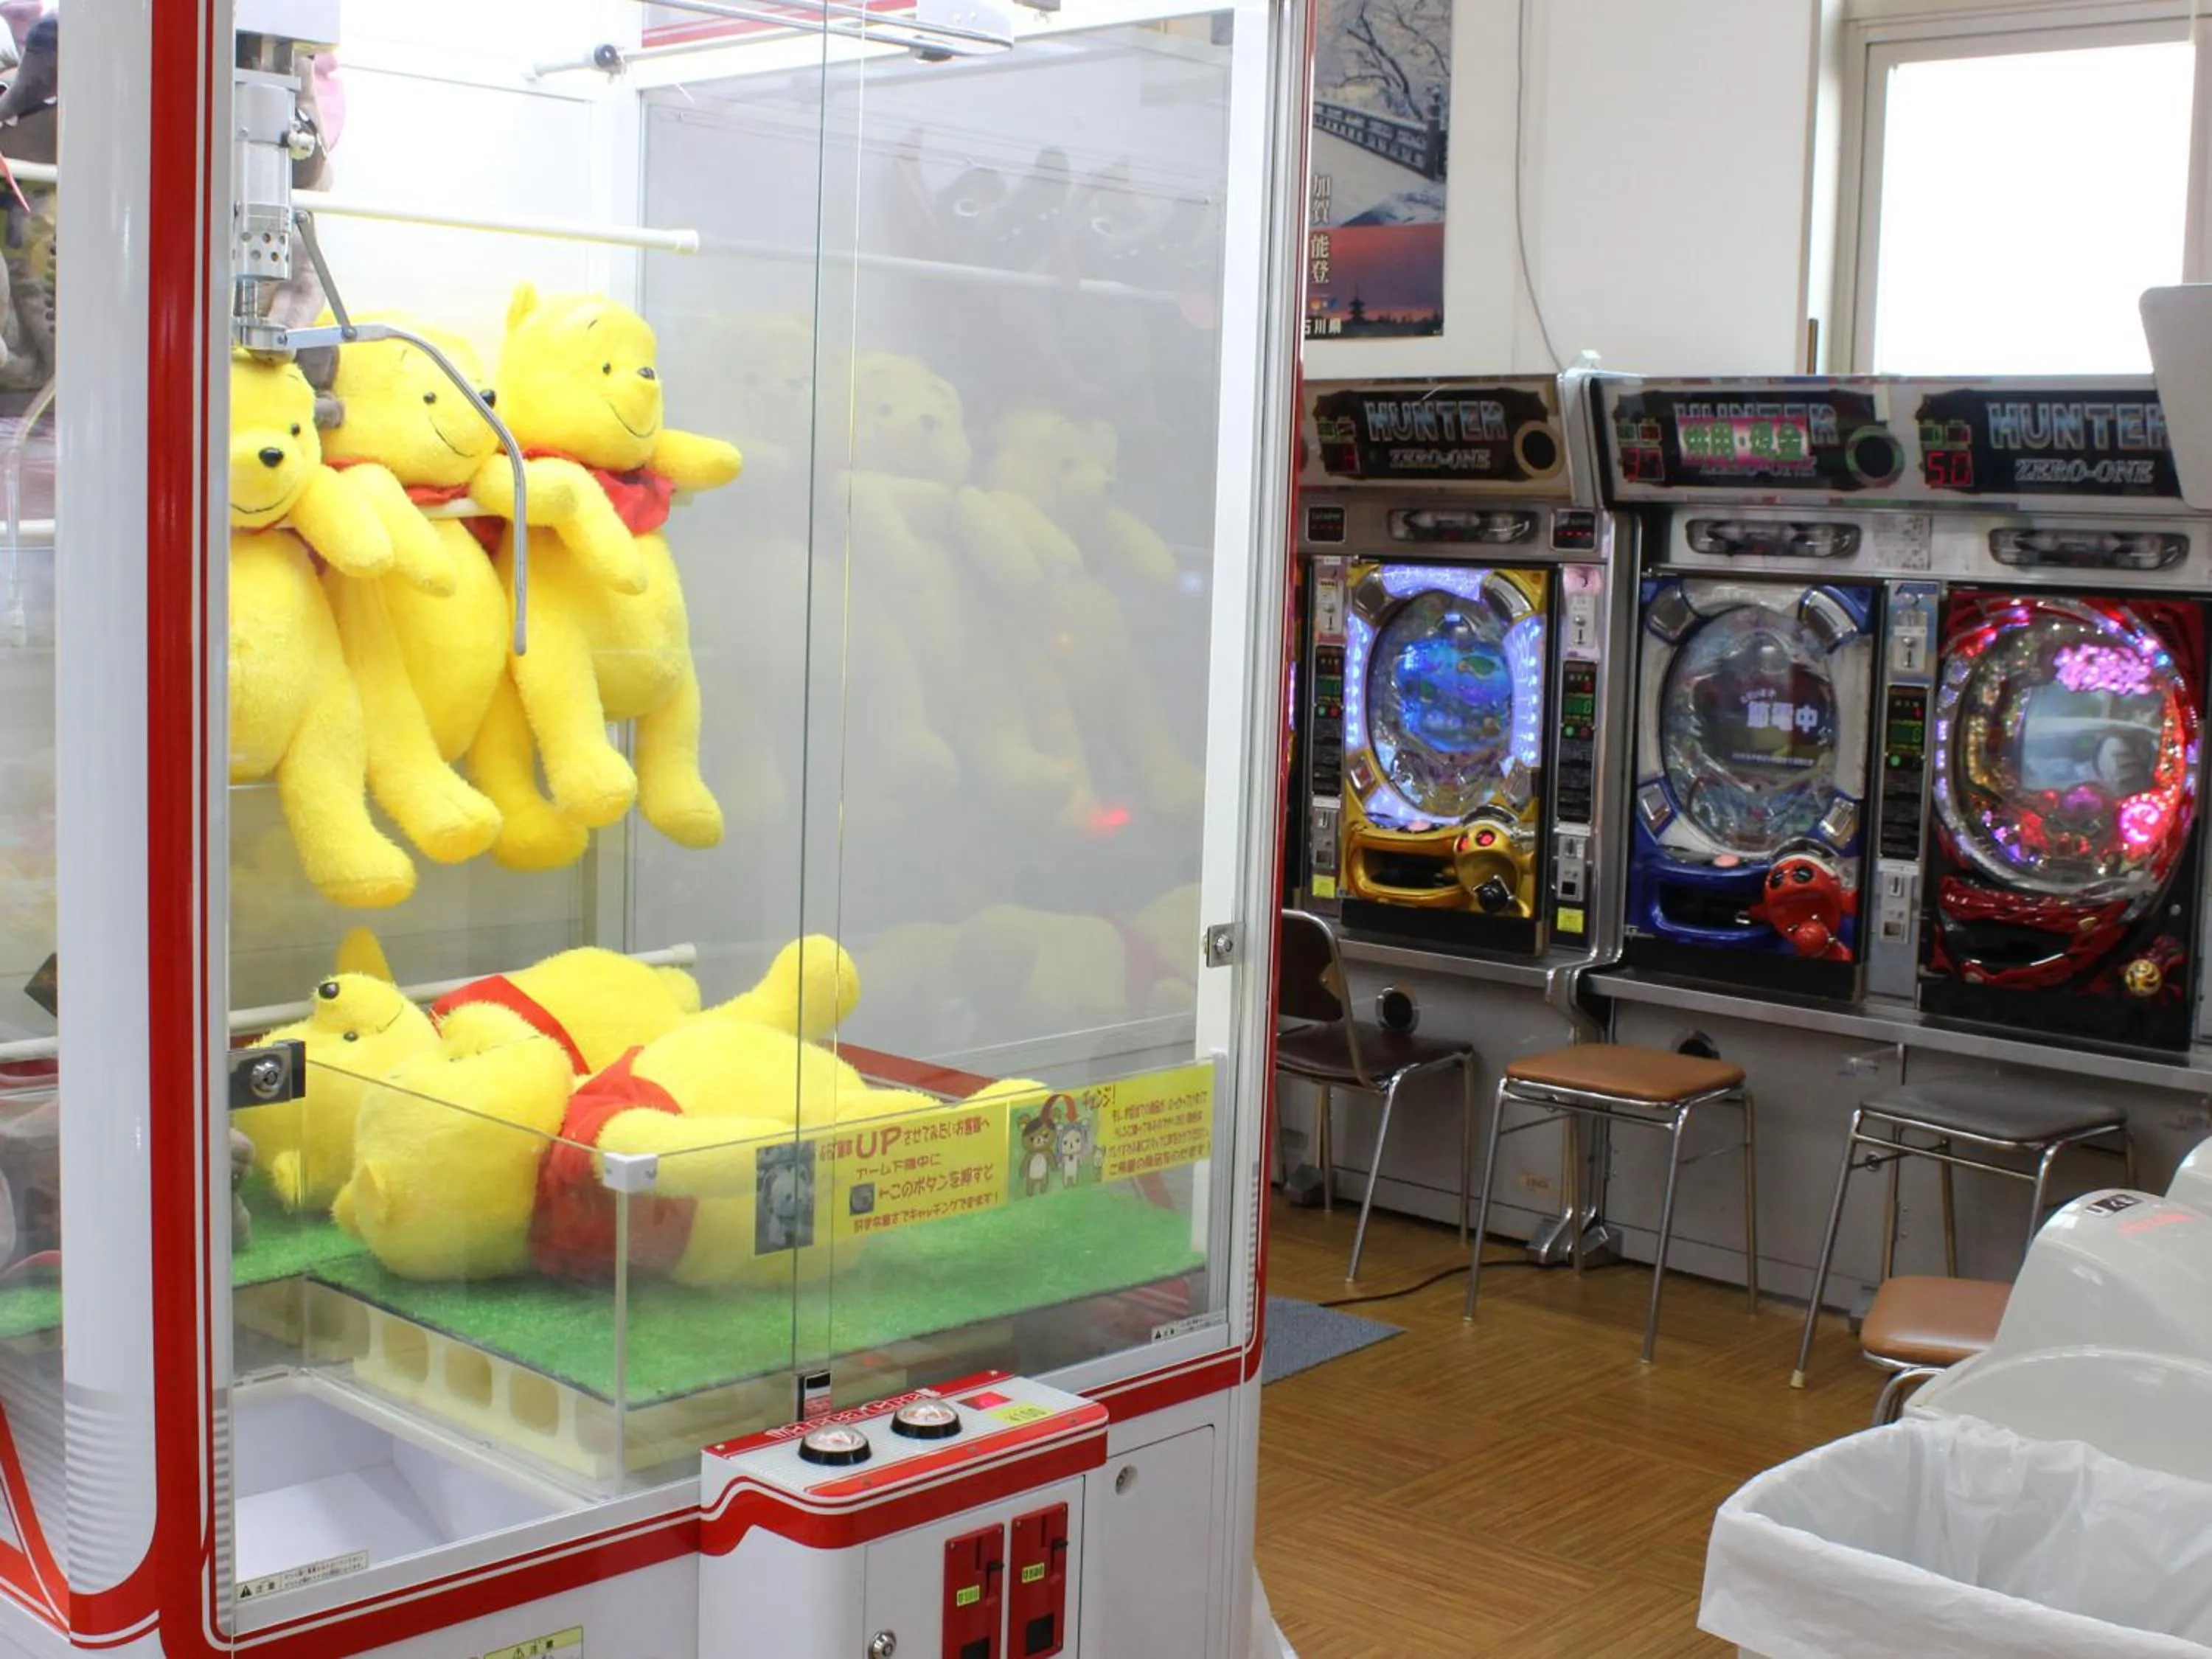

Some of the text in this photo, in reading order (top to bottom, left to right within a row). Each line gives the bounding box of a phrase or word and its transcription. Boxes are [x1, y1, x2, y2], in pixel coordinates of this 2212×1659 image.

[1310, 174, 1332, 284] 加賀 能登
[1363, 400, 1509, 442] HUNTER
[1389, 448, 1491, 470] ZERO-ONE
[2014, 458, 2156, 484] ZERO-ONE
